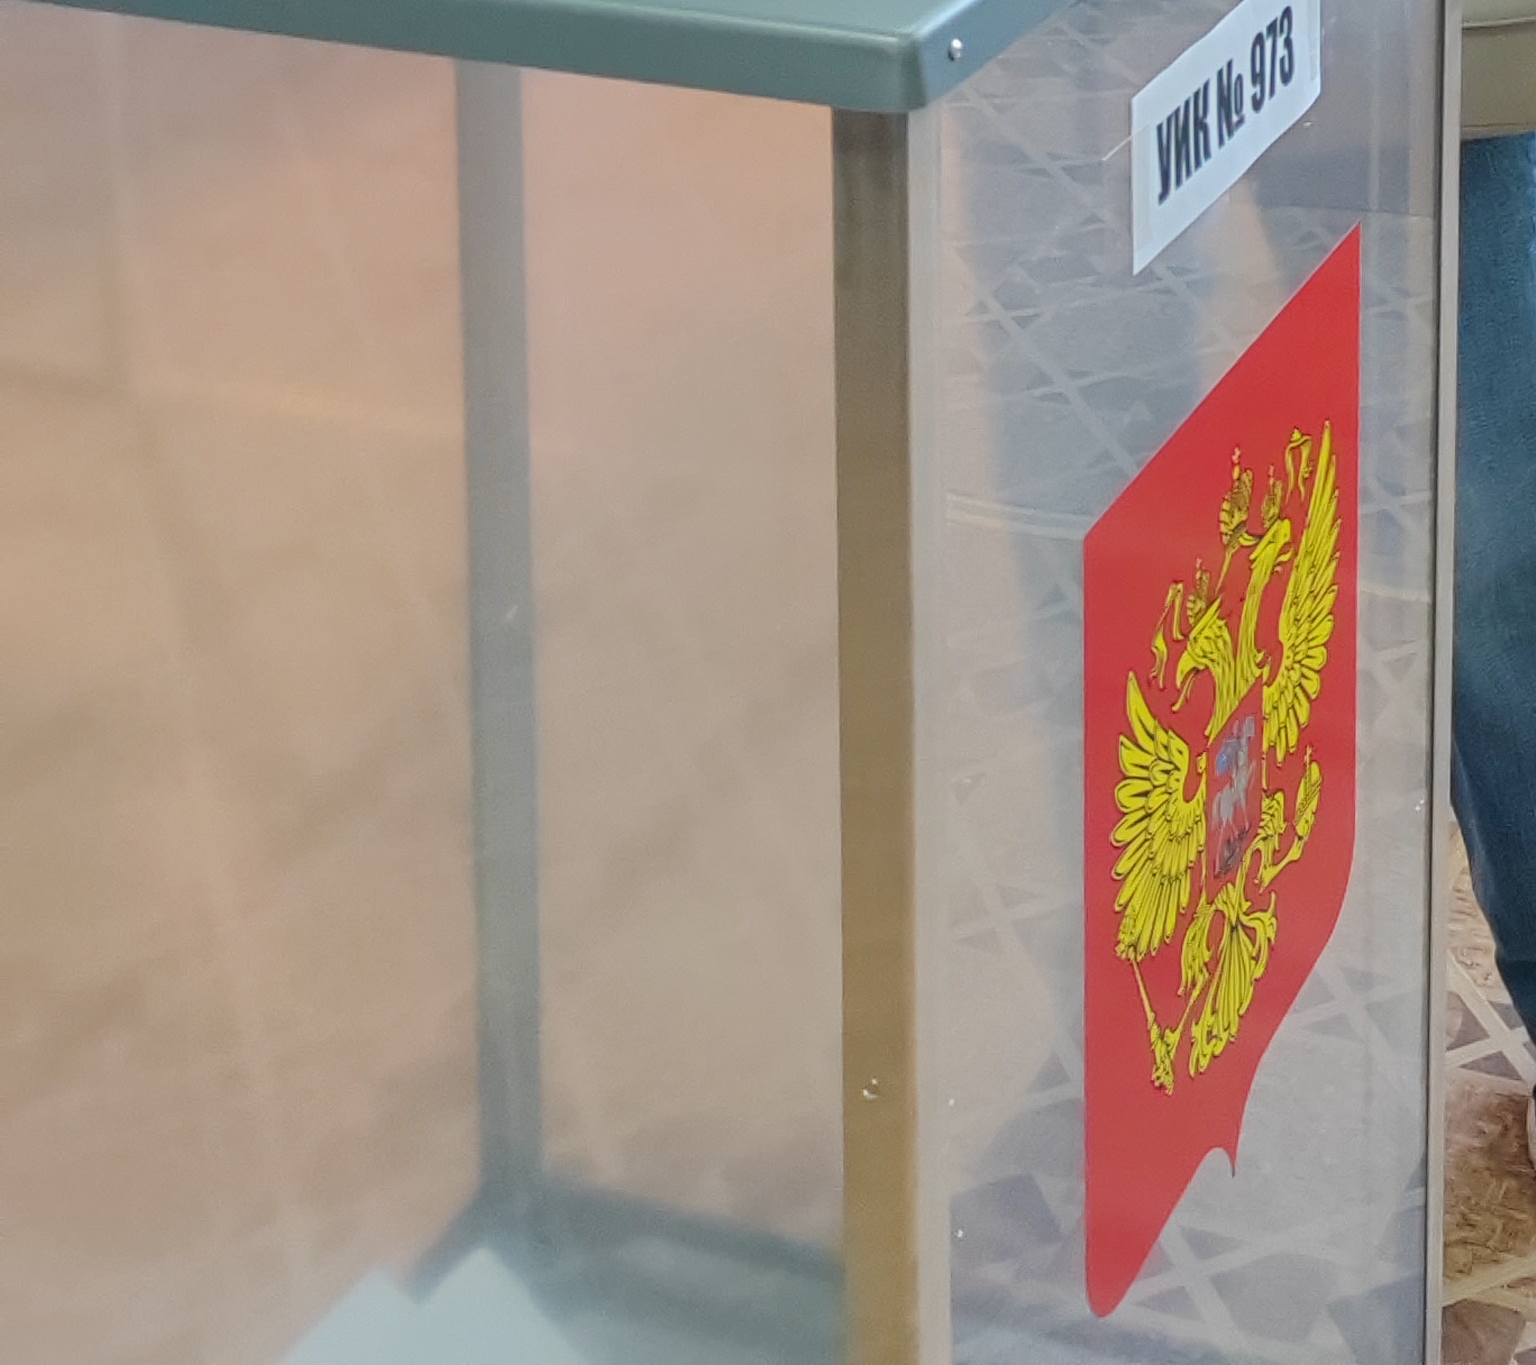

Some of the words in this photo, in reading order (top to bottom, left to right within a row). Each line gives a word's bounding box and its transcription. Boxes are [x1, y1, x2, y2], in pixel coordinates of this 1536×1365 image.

[1156, 77, 1212, 206] УИК
[1216, 58, 1245, 149] №
[1250, 6, 1295, 115] 973
